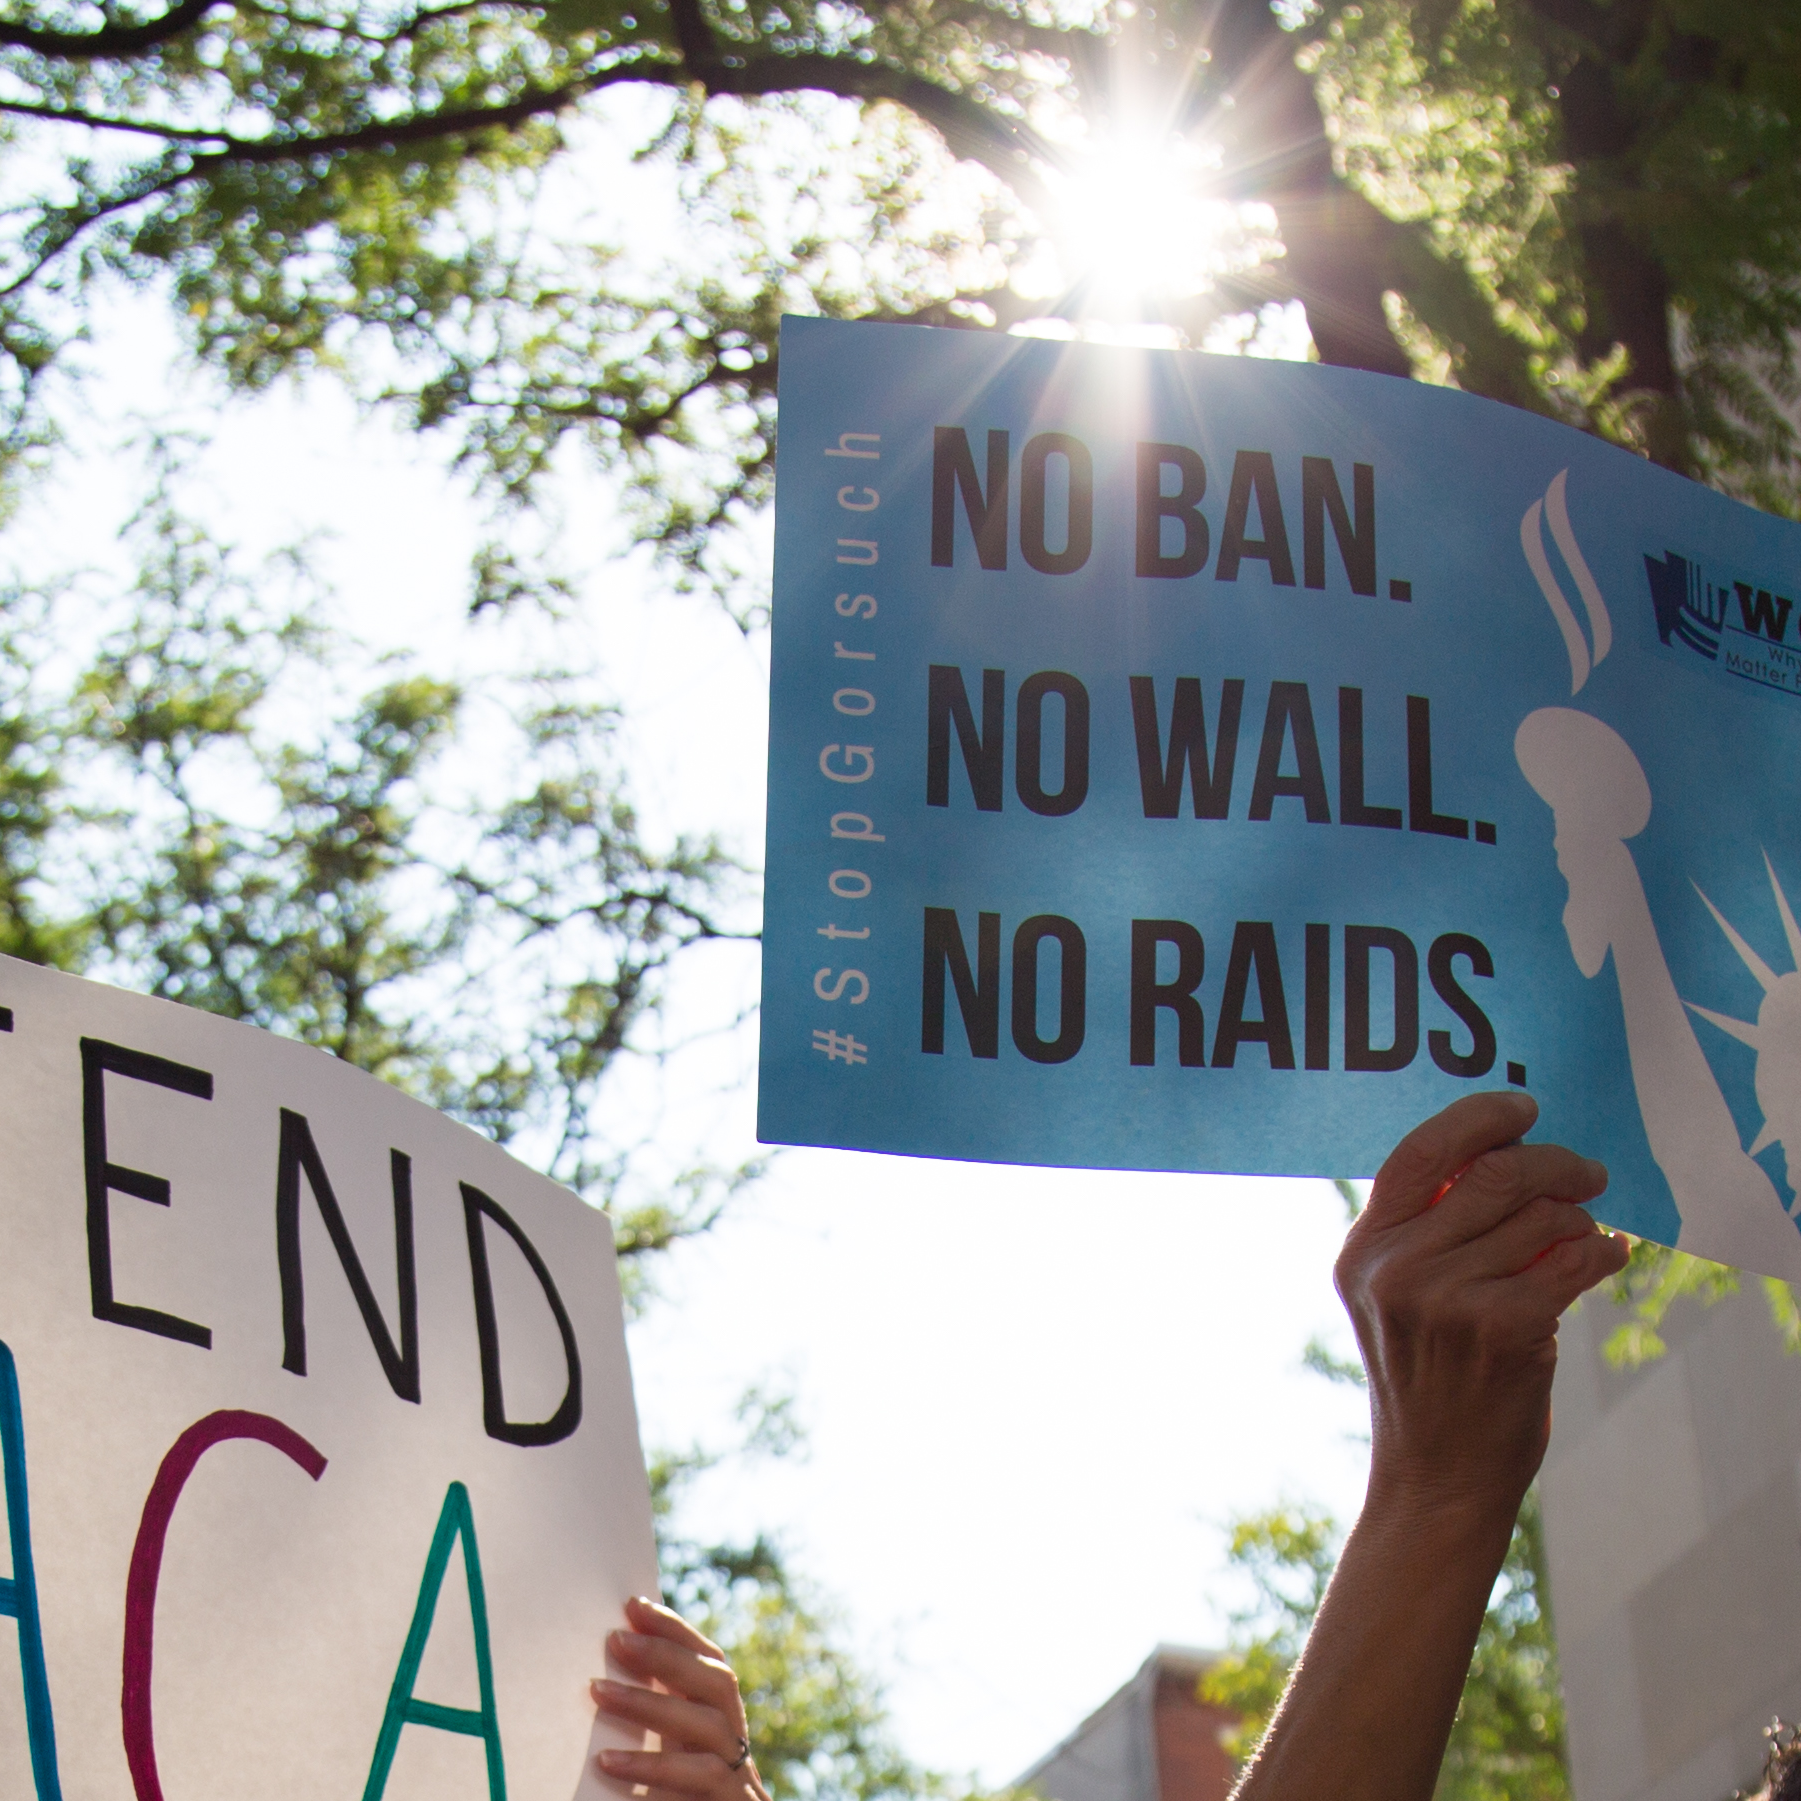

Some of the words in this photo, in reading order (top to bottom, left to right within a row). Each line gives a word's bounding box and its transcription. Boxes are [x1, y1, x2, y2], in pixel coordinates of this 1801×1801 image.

[930, 425, 1094, 577] NO
[1134, 441, 1412, 603] BAN.
[812, 428, 885, 1066] #StopGorsuch
[925, 664, 1090, 817] NO
[1128, 675, 1498, 846] WALL.
[1725, 651, 1788, 684] Matter
[919, 906, 1088, 1065] NO
[1129, 917, 1528, 1088] RAIDS.
